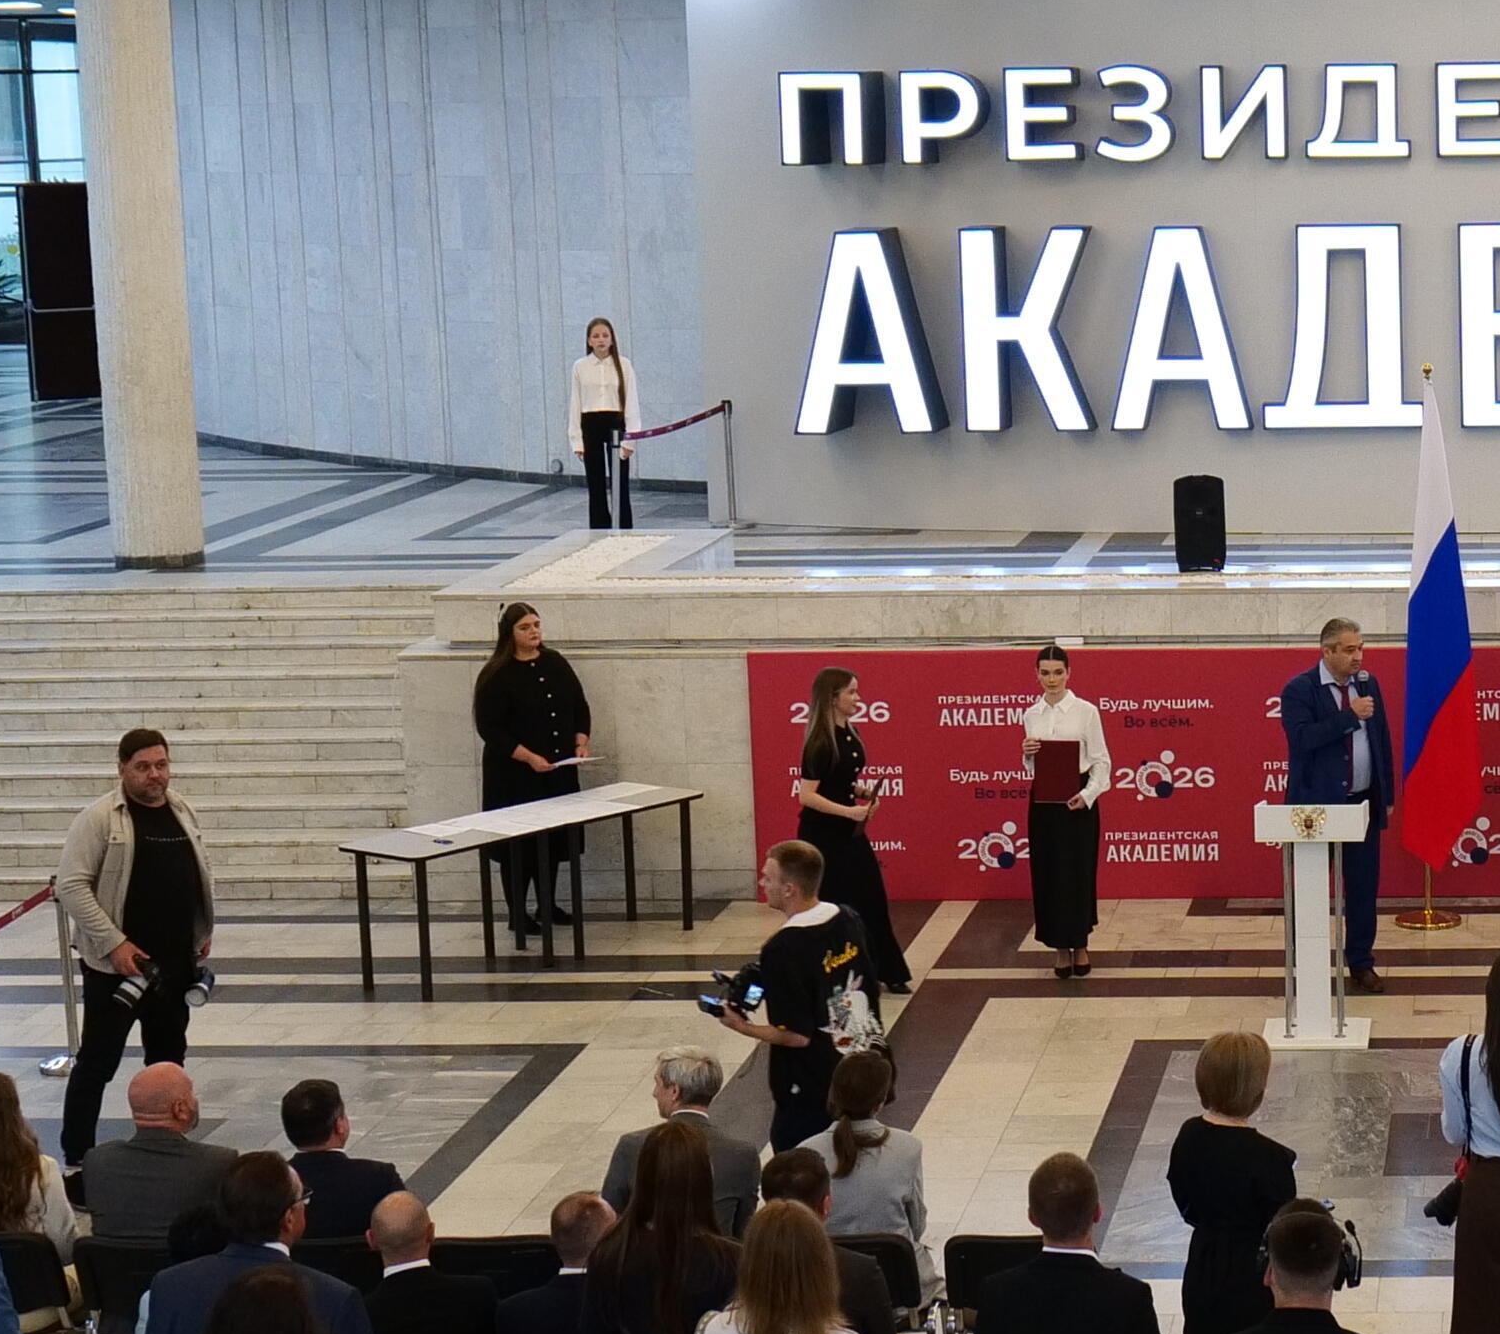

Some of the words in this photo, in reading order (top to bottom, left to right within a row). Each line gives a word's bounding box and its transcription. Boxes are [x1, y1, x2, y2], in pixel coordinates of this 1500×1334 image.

[1100, 697, 1138, 712] Будь
[1143, 698, 1214, 711] лучшим.
[790, 701, 891, 724] 226
[939, 707, 1025, 727] АКАДЕМ
[1124, 717, 1145, 728] Во
[1150, 715, 1195, 728] всём.
[950, 769, 988, 784] Будь
[1115, 761, 1216, 798] 2026
[975, 788, 995, 799] Во
[1105, 831, 1218, 840] ПРЕЗИДЕНТСКАЯ
[1106, 844, 1219, 862] АКАДЕМИЯ
